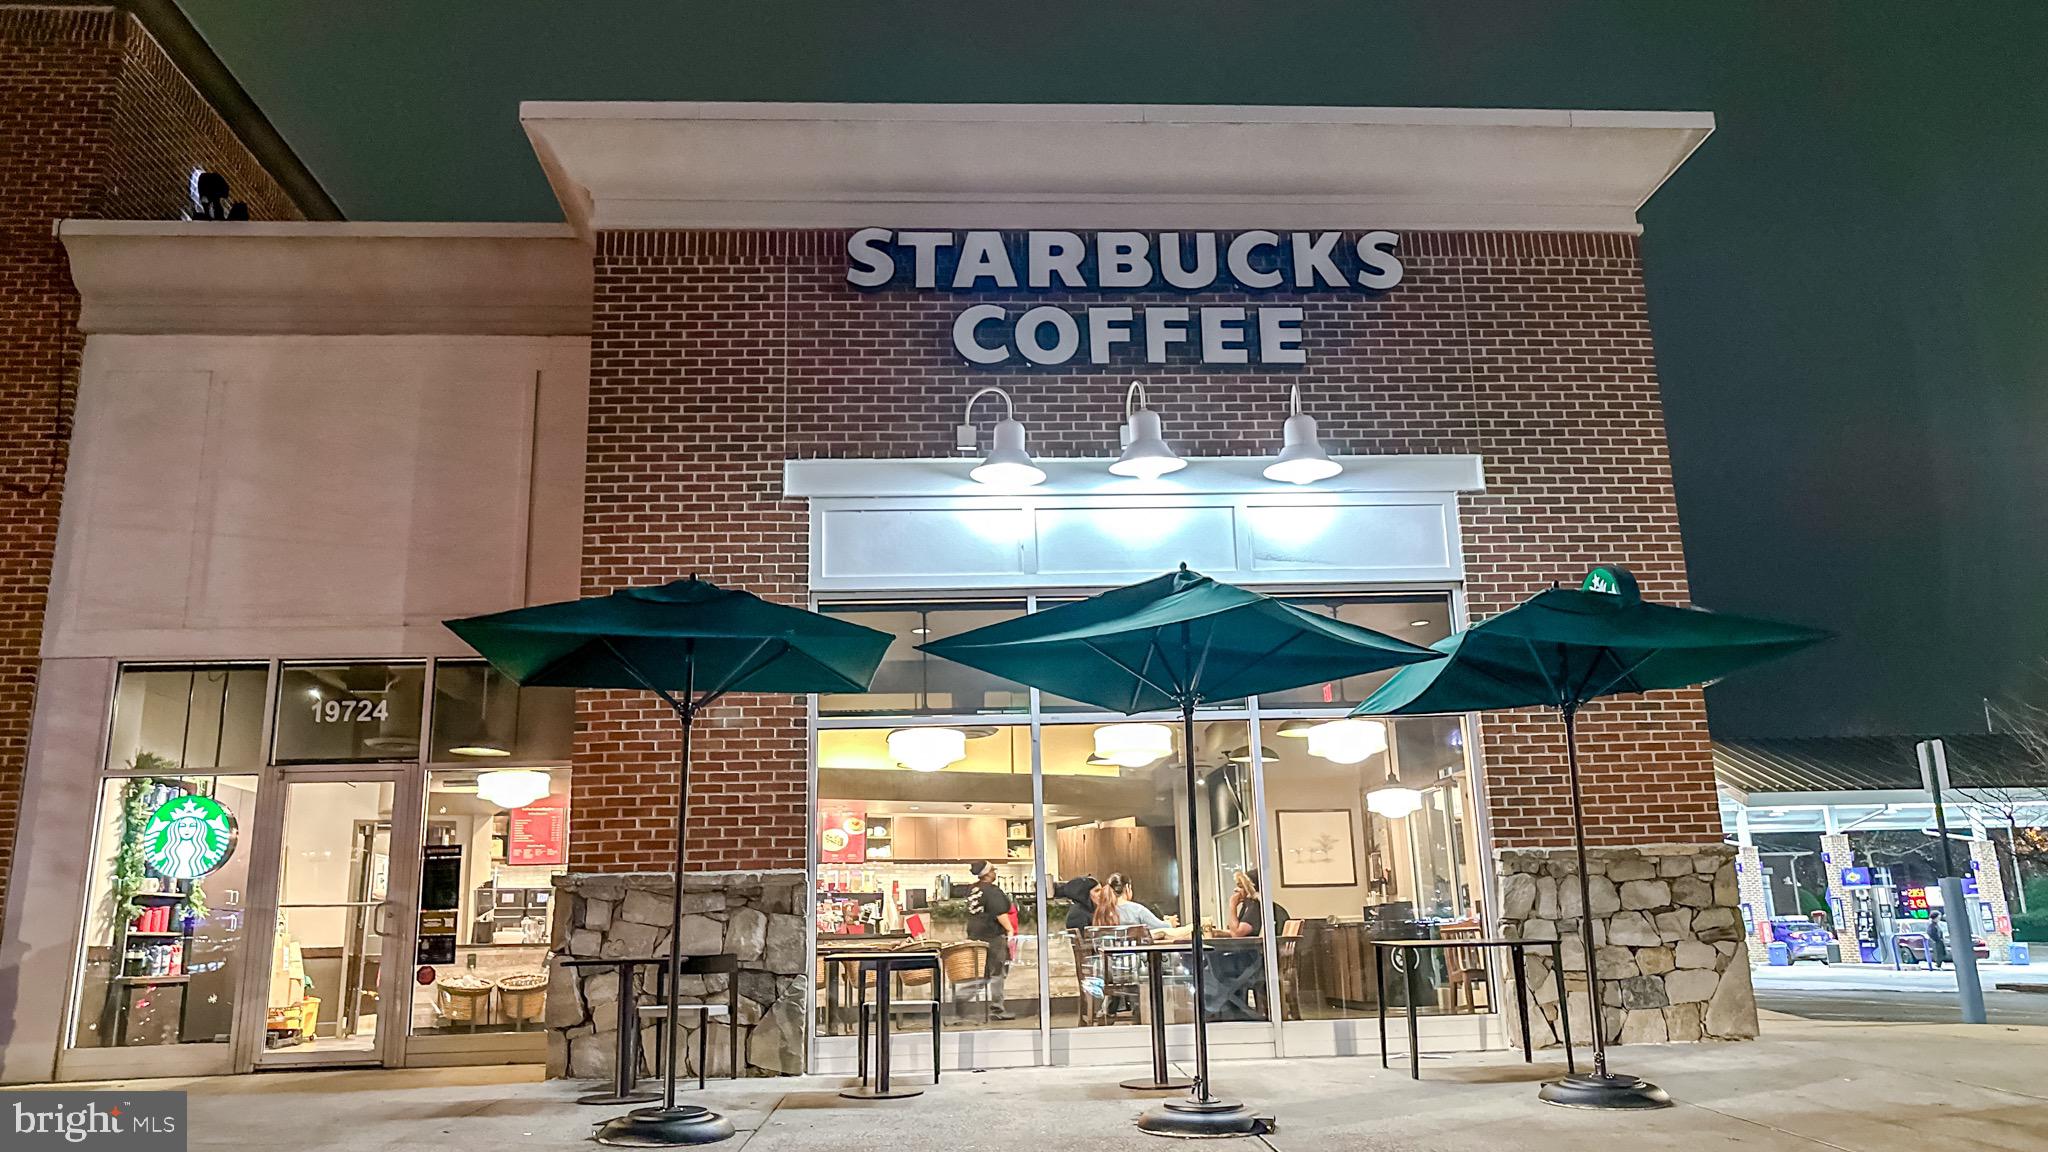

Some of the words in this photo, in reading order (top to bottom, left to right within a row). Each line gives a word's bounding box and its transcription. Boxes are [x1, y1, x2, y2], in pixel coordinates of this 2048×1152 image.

[846, 228, 1404, 290] STARBUCKS
[952, 304, 1306, 365] COFFEE
[311, 699, 389, 723] 19724
